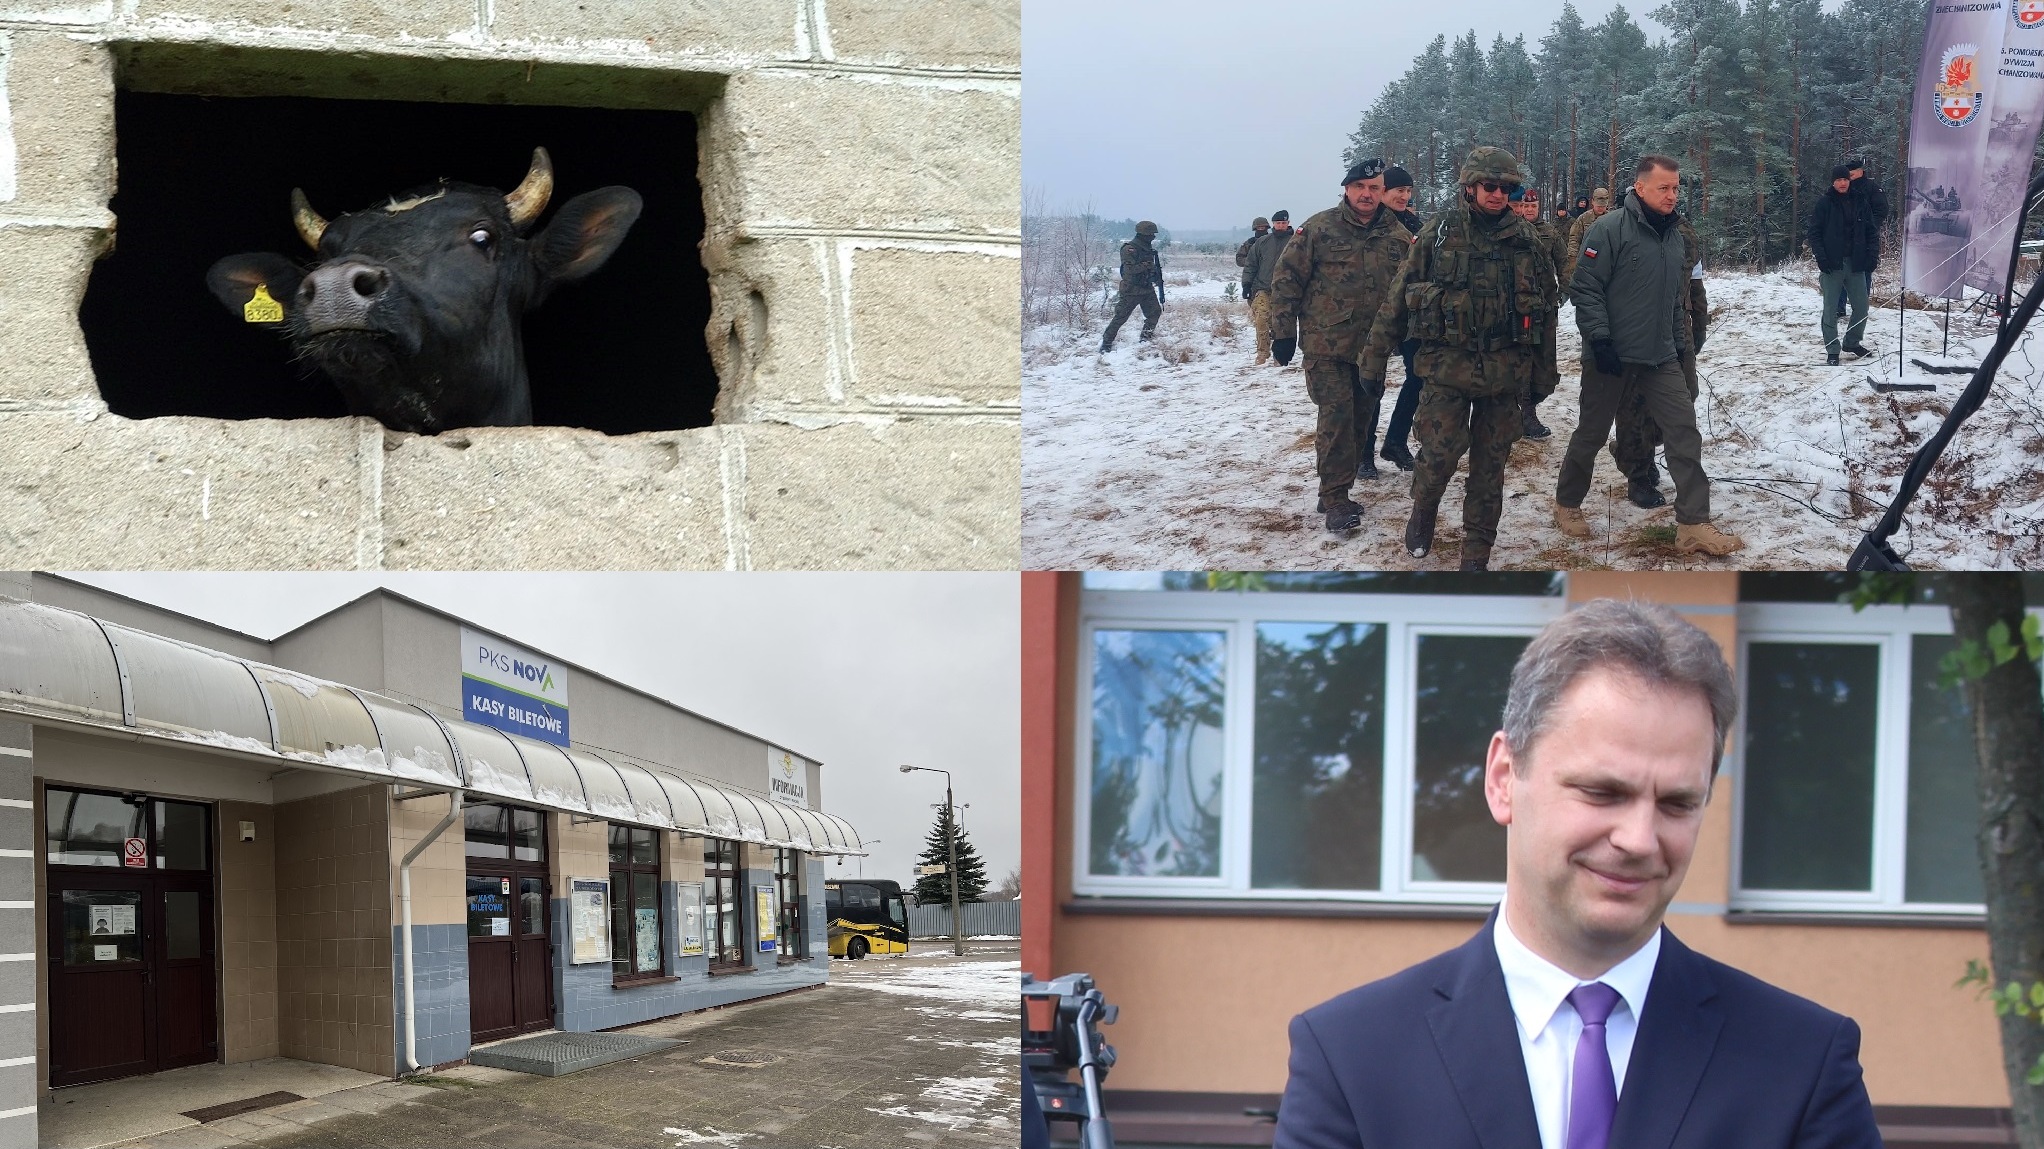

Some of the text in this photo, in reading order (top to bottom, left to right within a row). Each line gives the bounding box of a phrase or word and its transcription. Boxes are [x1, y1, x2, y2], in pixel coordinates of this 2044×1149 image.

[2008, 47, 2044, 58] POMORSK
[2003, 58, 2035, 67] DYWIZJA
[479, 646, 555, 692] PKS NOVA
[472, 694, 562, 734] KASY BILETOWE
[477, 894, 496, 903] KASY
[470, 903, 503, 912] BILETOWE
